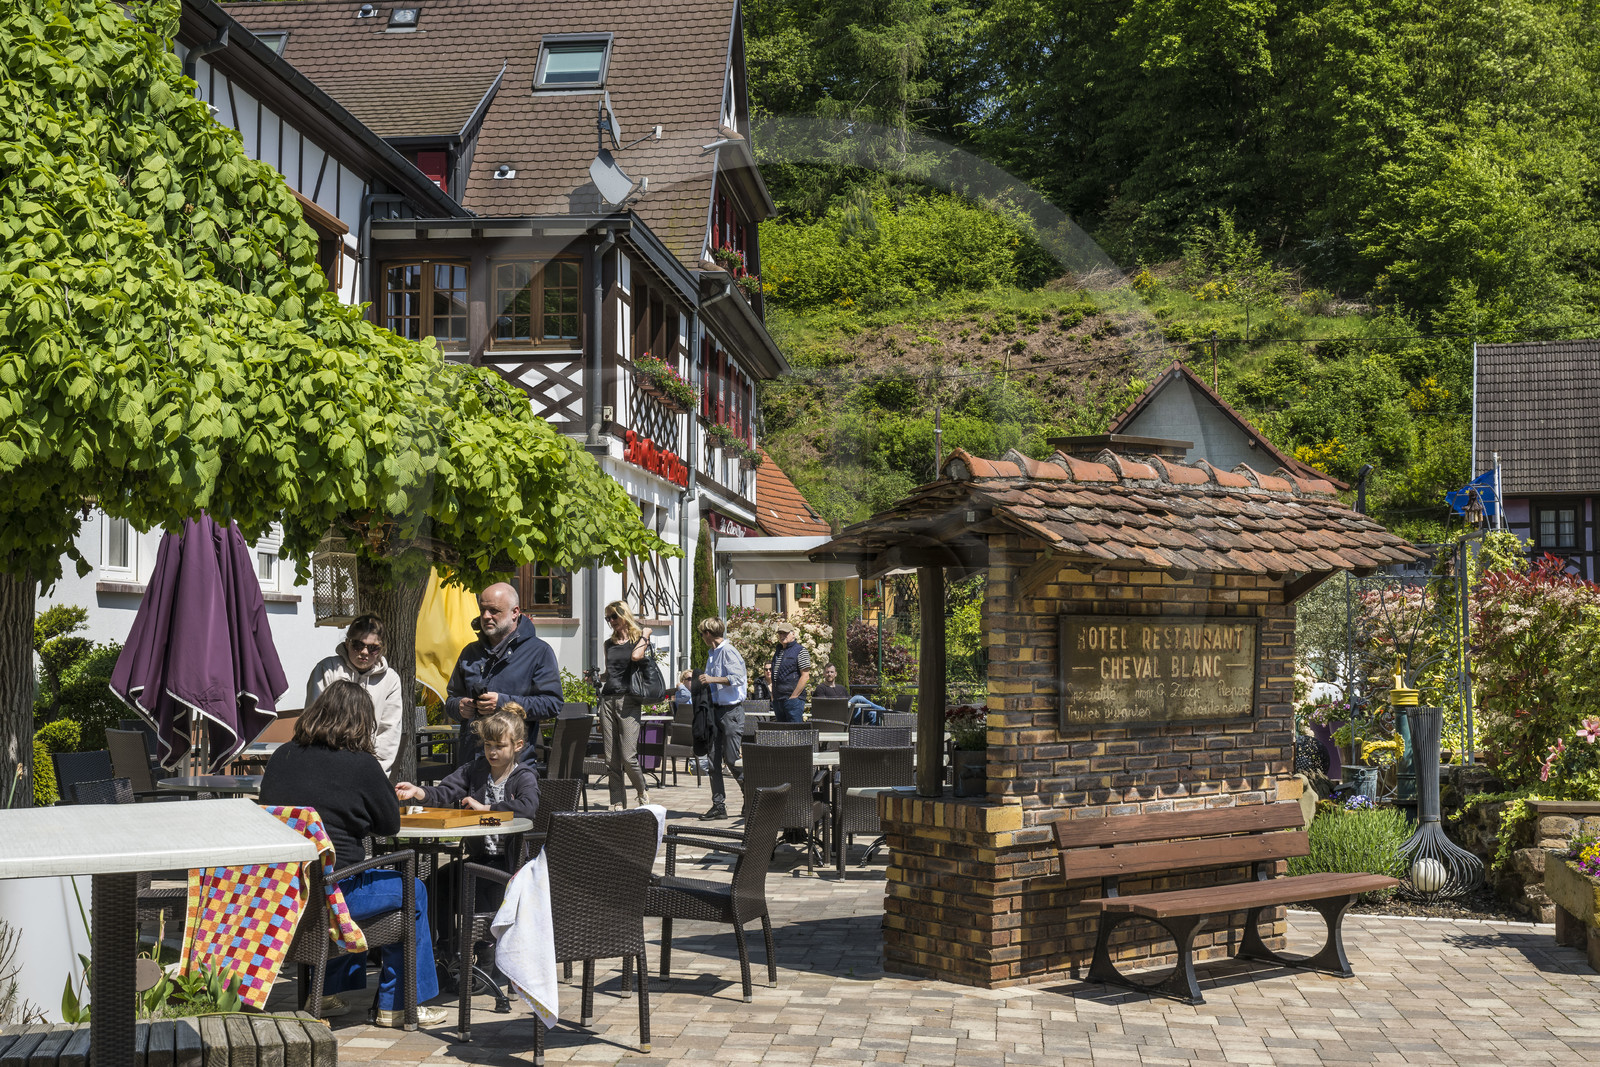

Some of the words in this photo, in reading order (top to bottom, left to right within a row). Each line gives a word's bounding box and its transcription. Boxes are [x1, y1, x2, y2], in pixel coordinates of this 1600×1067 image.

[1077, 626, 1129, 650] HOTEL
[1142, 626, 1244, 650] RESTAURANT
[1100, 655, 1162, 680] CHEVAL
[1171, 655, 1222, 678] BLANC
